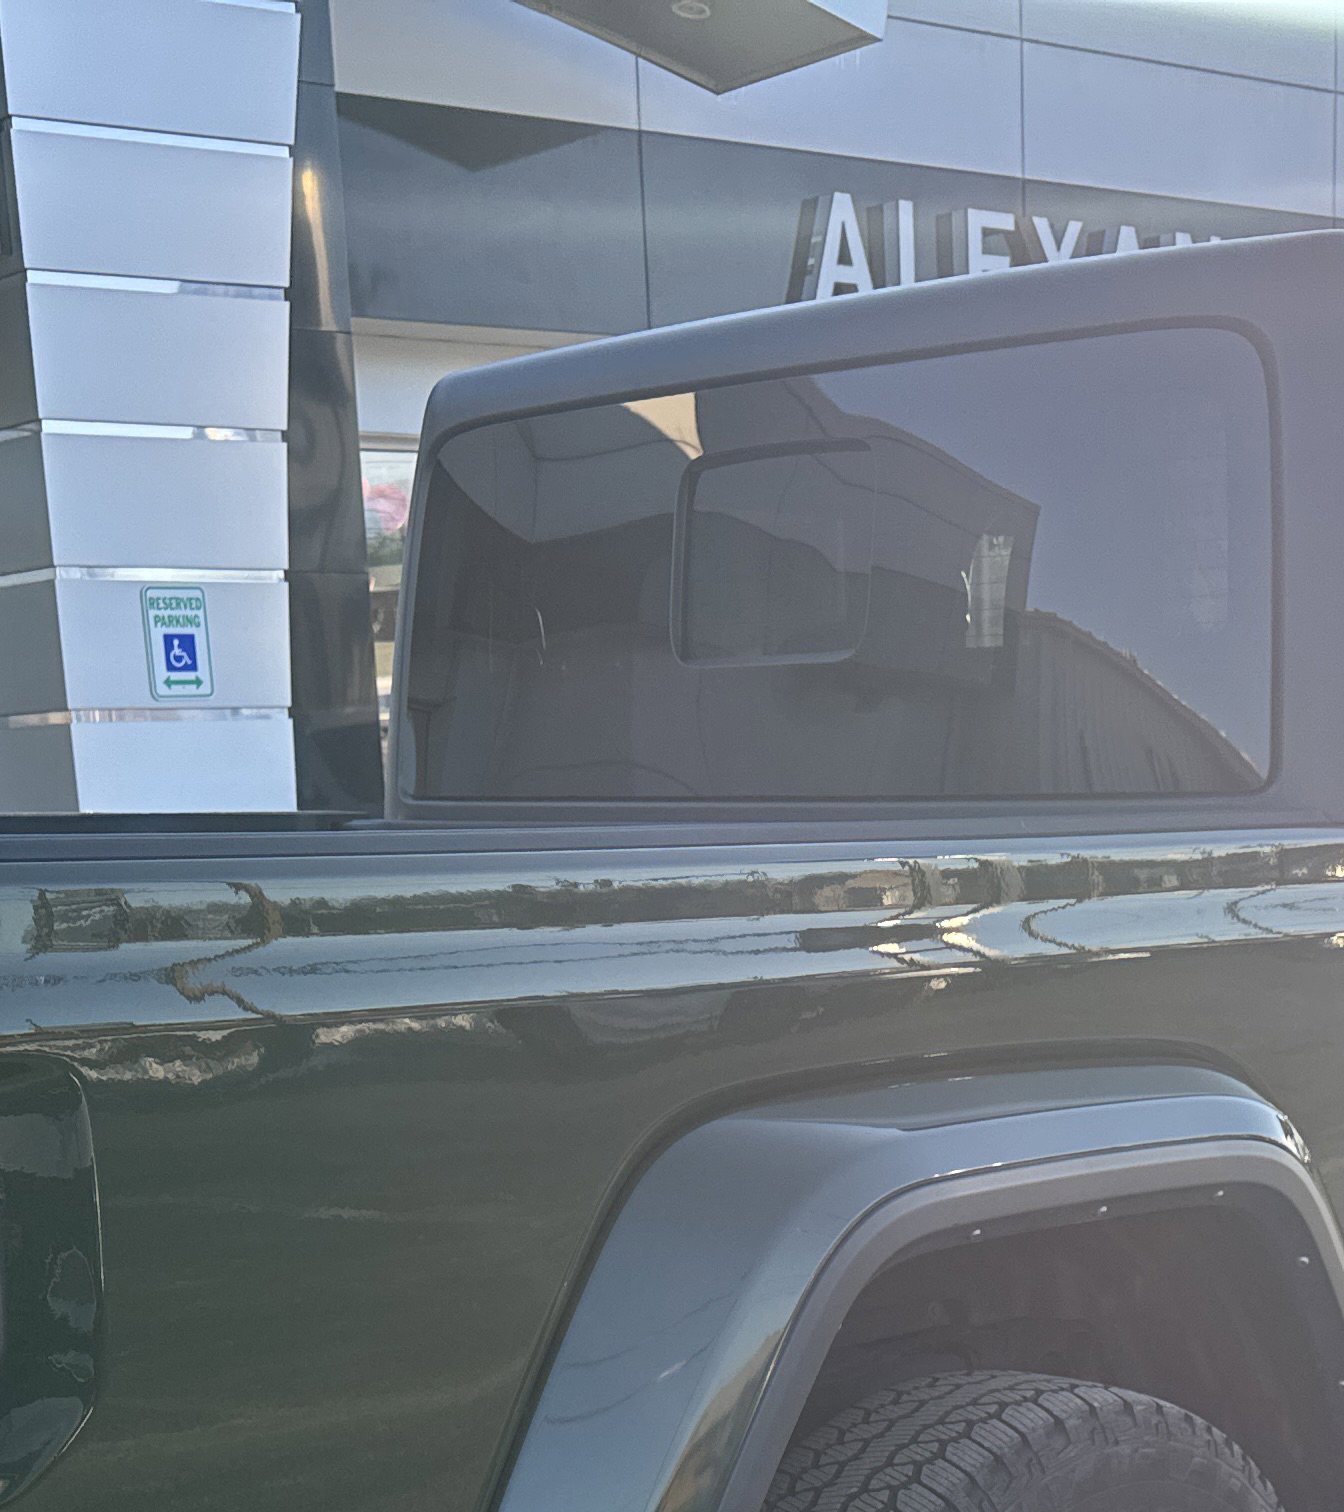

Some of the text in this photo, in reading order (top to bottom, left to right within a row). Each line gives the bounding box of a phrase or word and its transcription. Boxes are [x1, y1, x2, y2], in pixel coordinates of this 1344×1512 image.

[814, 190, 1222, 302] ALE
[148, 596, 202, 611] RESERVED
[153, 614, 201, 628] PARKING
